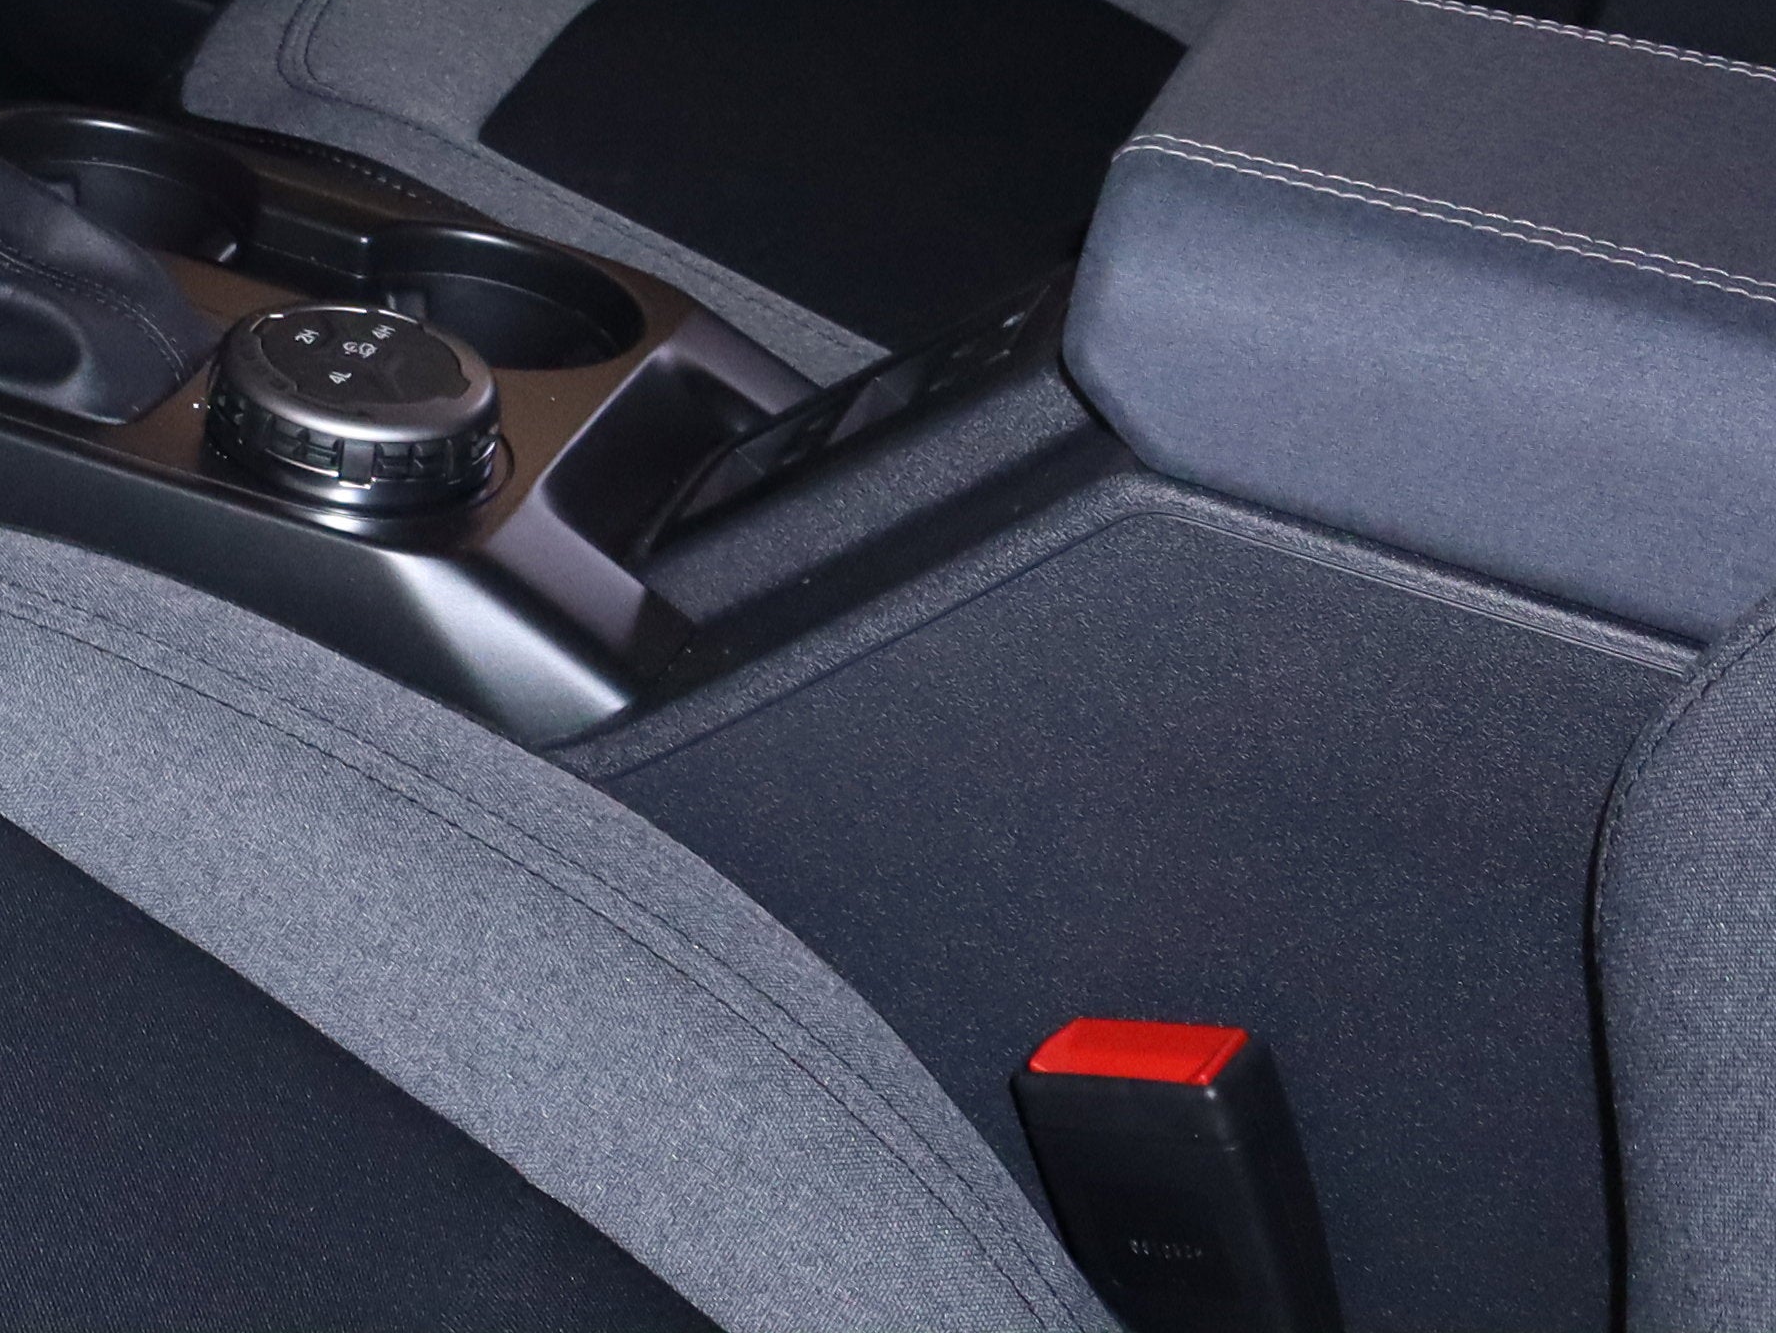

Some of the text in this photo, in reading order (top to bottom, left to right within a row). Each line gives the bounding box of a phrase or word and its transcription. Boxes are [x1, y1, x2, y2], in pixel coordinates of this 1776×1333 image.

[294, 328, 320, 346] 2H
[371, 324, 396, 341] 4H
[328, 370, 352, 386] 4L
